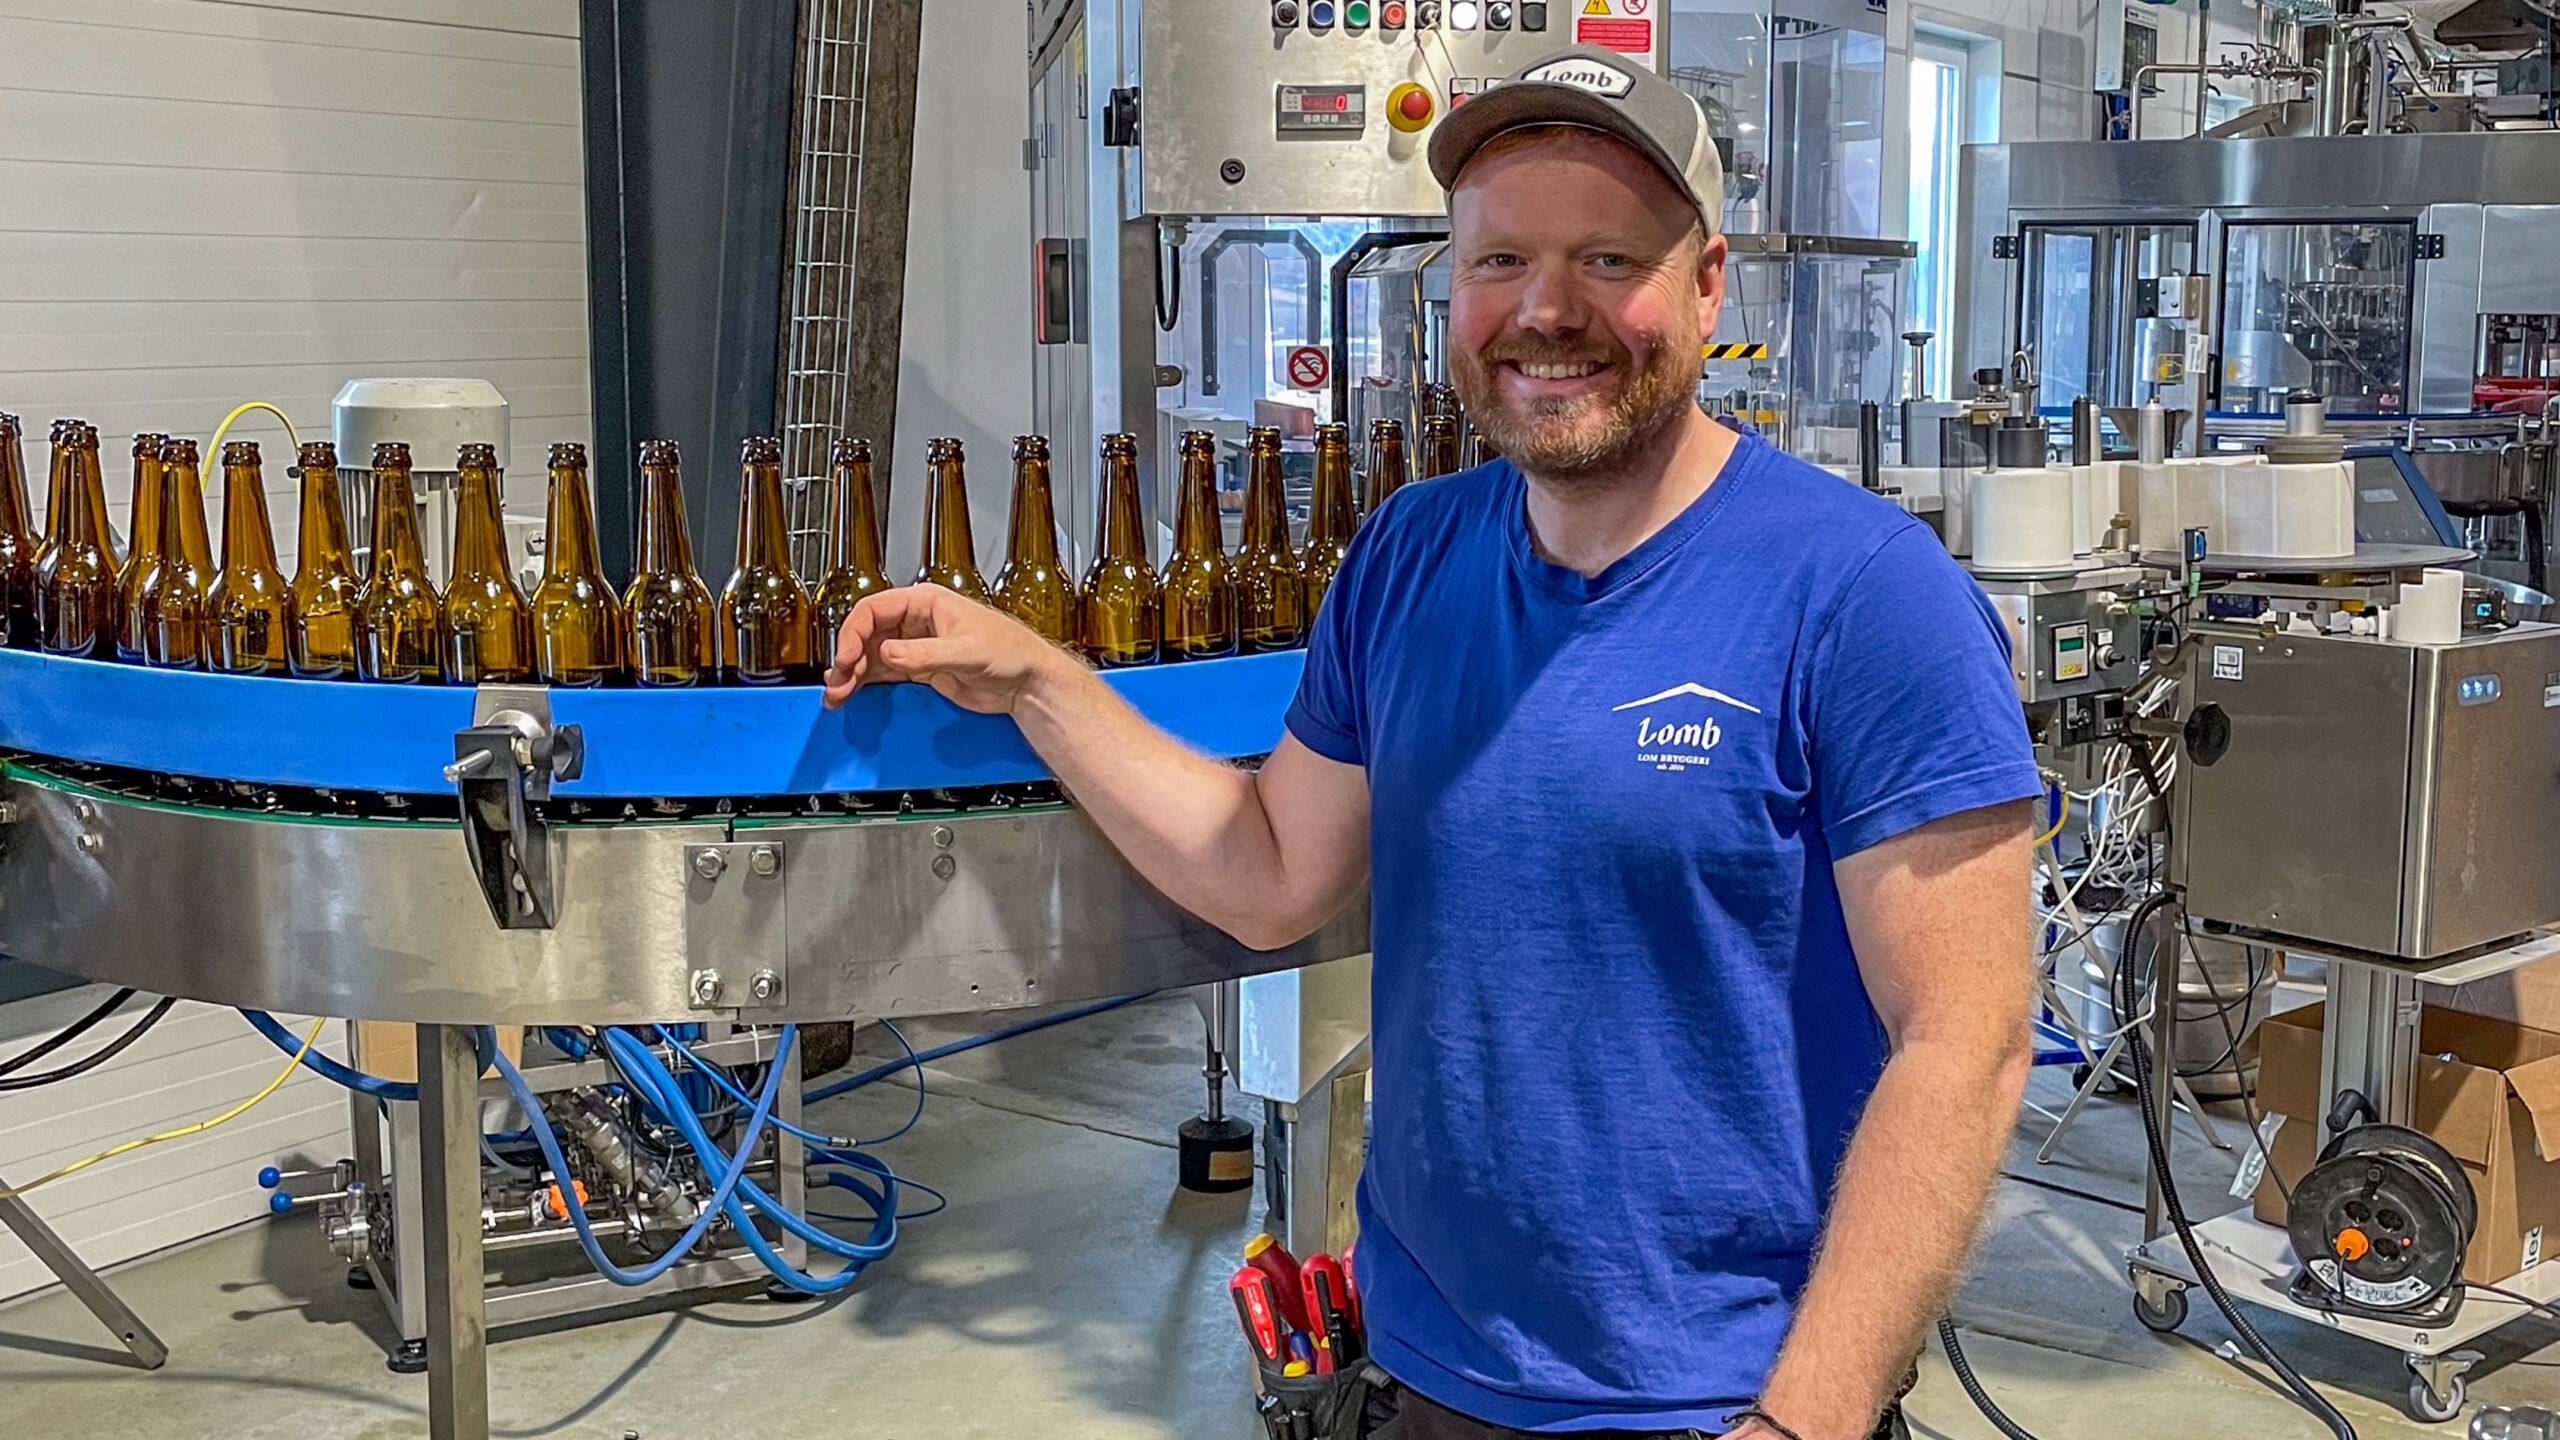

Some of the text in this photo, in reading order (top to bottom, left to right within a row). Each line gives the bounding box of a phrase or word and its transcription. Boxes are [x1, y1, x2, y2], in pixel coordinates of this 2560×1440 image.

[1637, 717, 1721, 750] Lomb
[1637, 754, 1710, 765] LOM BRYGGERI
